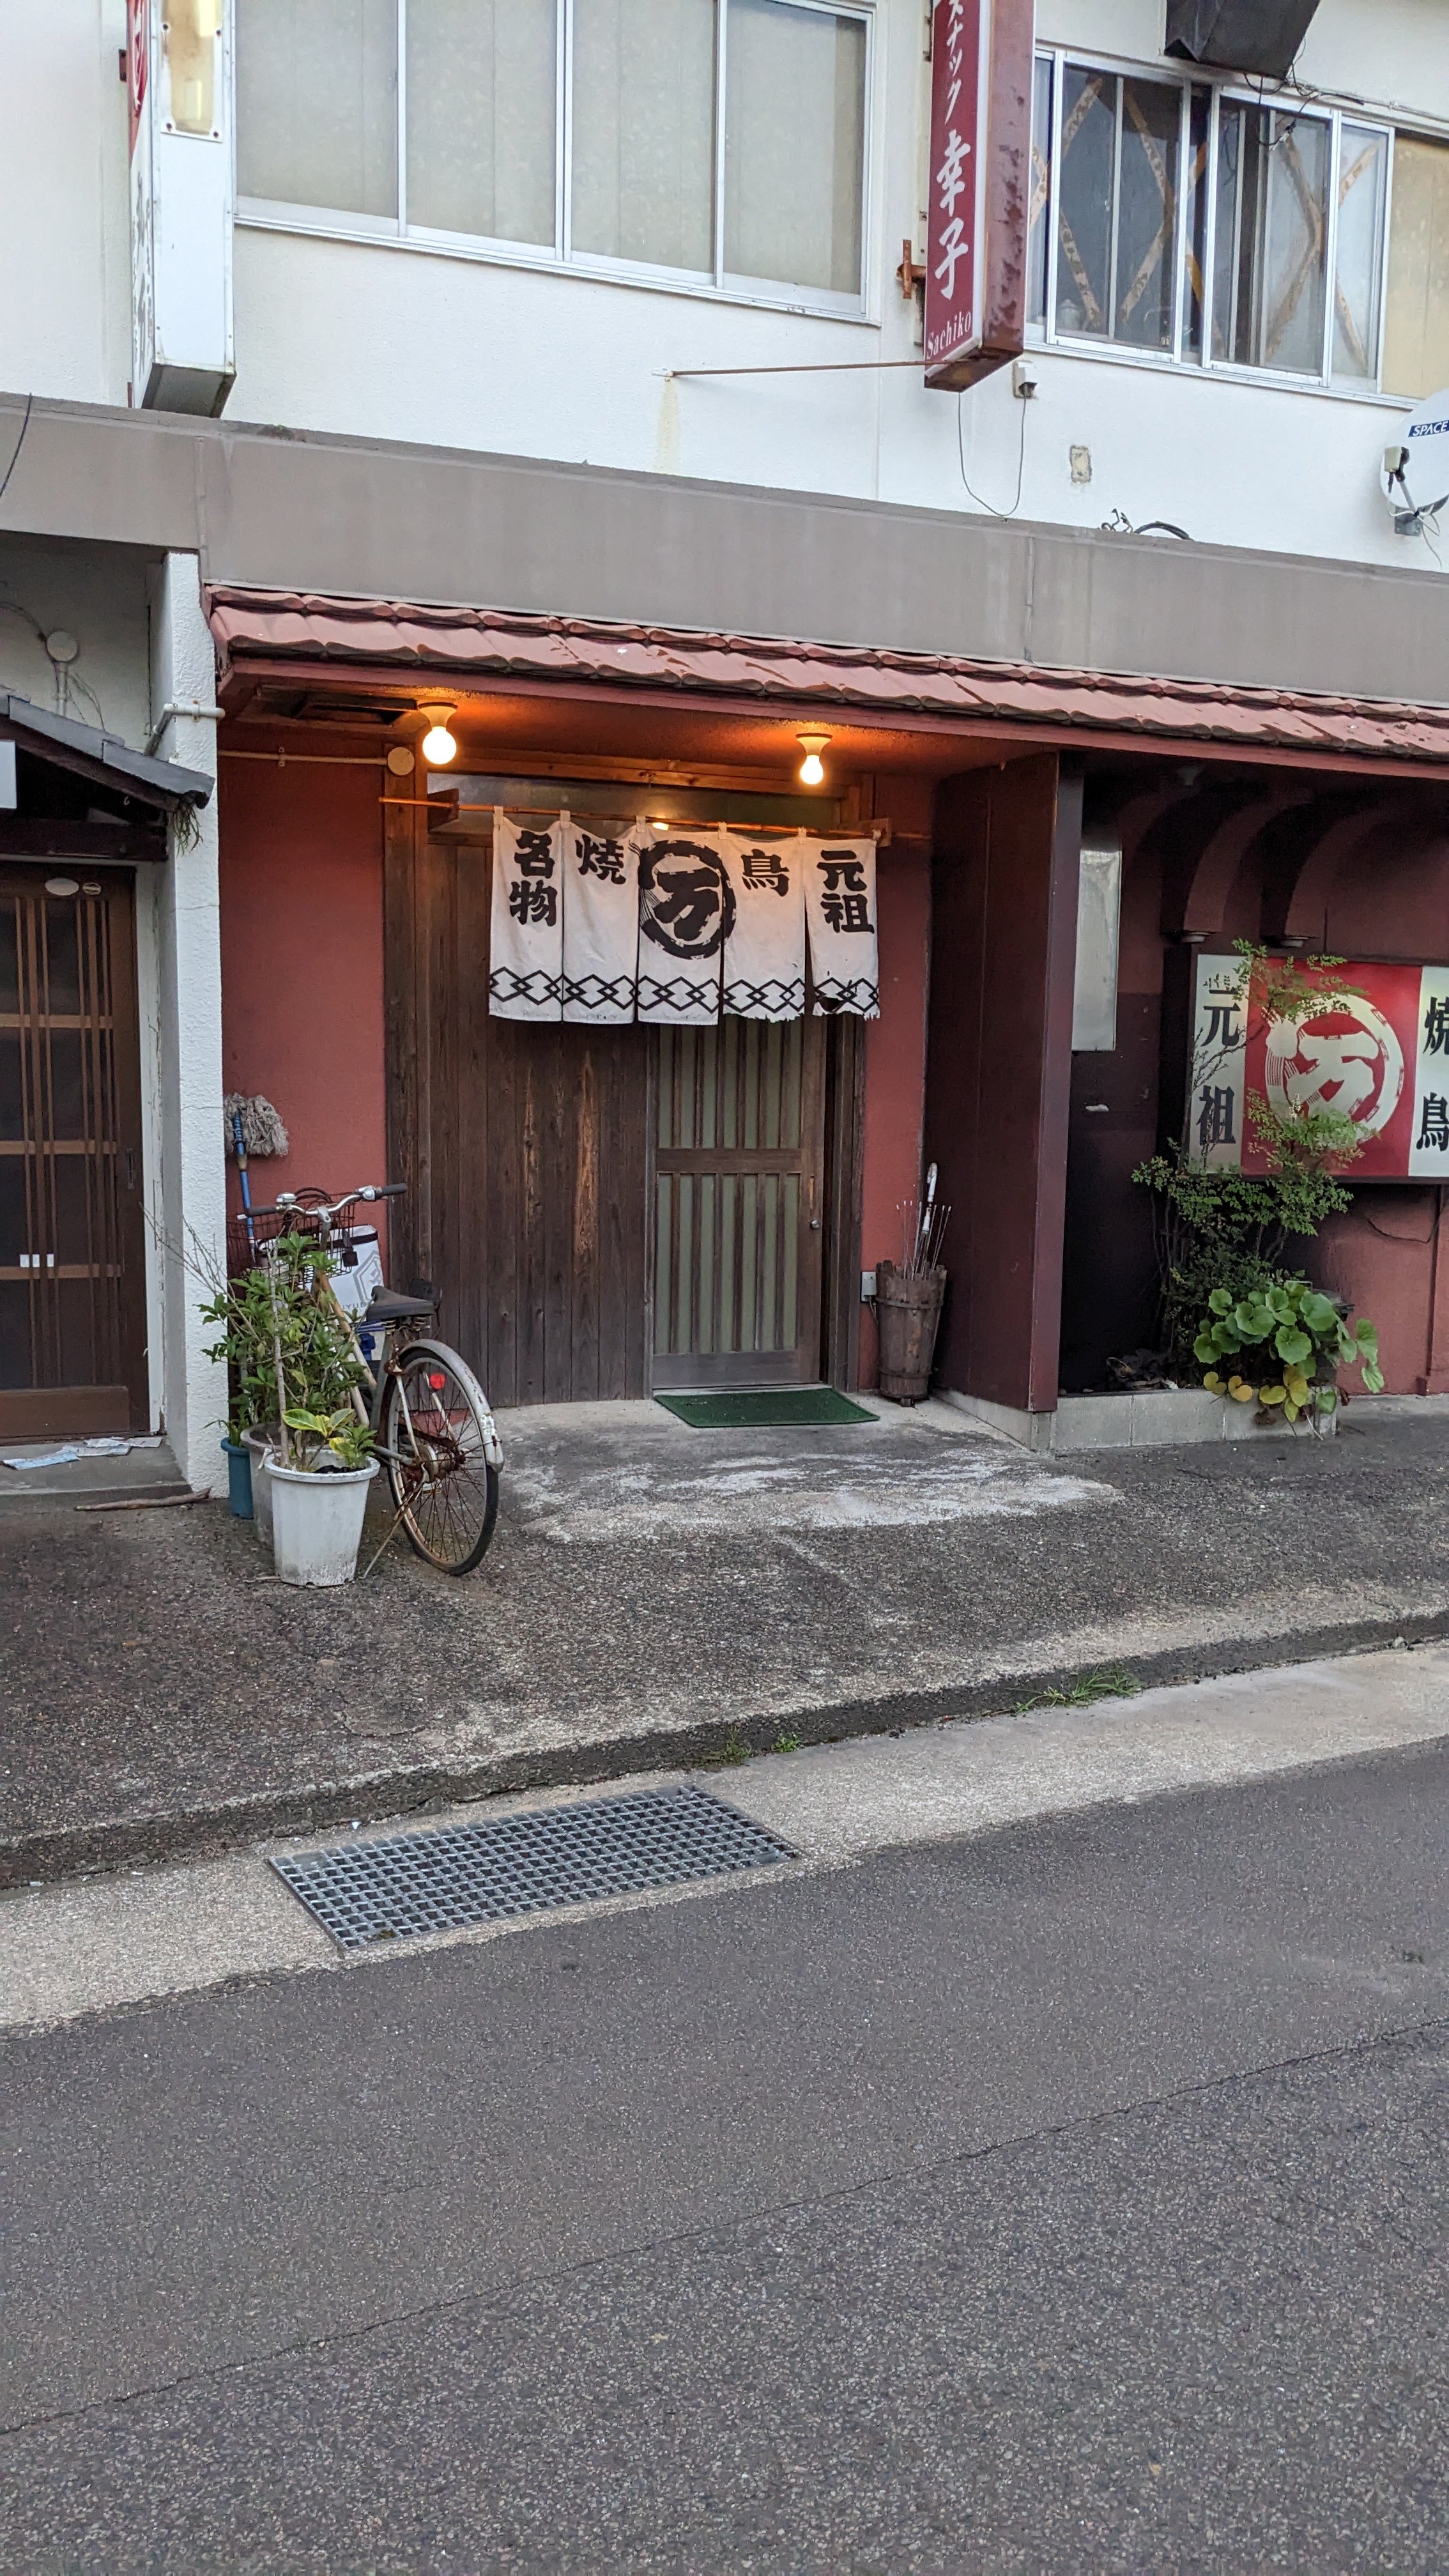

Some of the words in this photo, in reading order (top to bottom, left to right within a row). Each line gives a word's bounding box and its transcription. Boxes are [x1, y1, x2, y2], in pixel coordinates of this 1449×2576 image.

[935, 129, 970, 299] 幸子
[926, 310, 971, 359] Sachiko
[1412, 421, 1448, 436] SPACE
[509, 830, 558, 927] 名物
[740, 848, 790, 897] 鳥
[816, 850, 875, 934] 元祖
[1197, 986, 1241, 1146] 元祖
